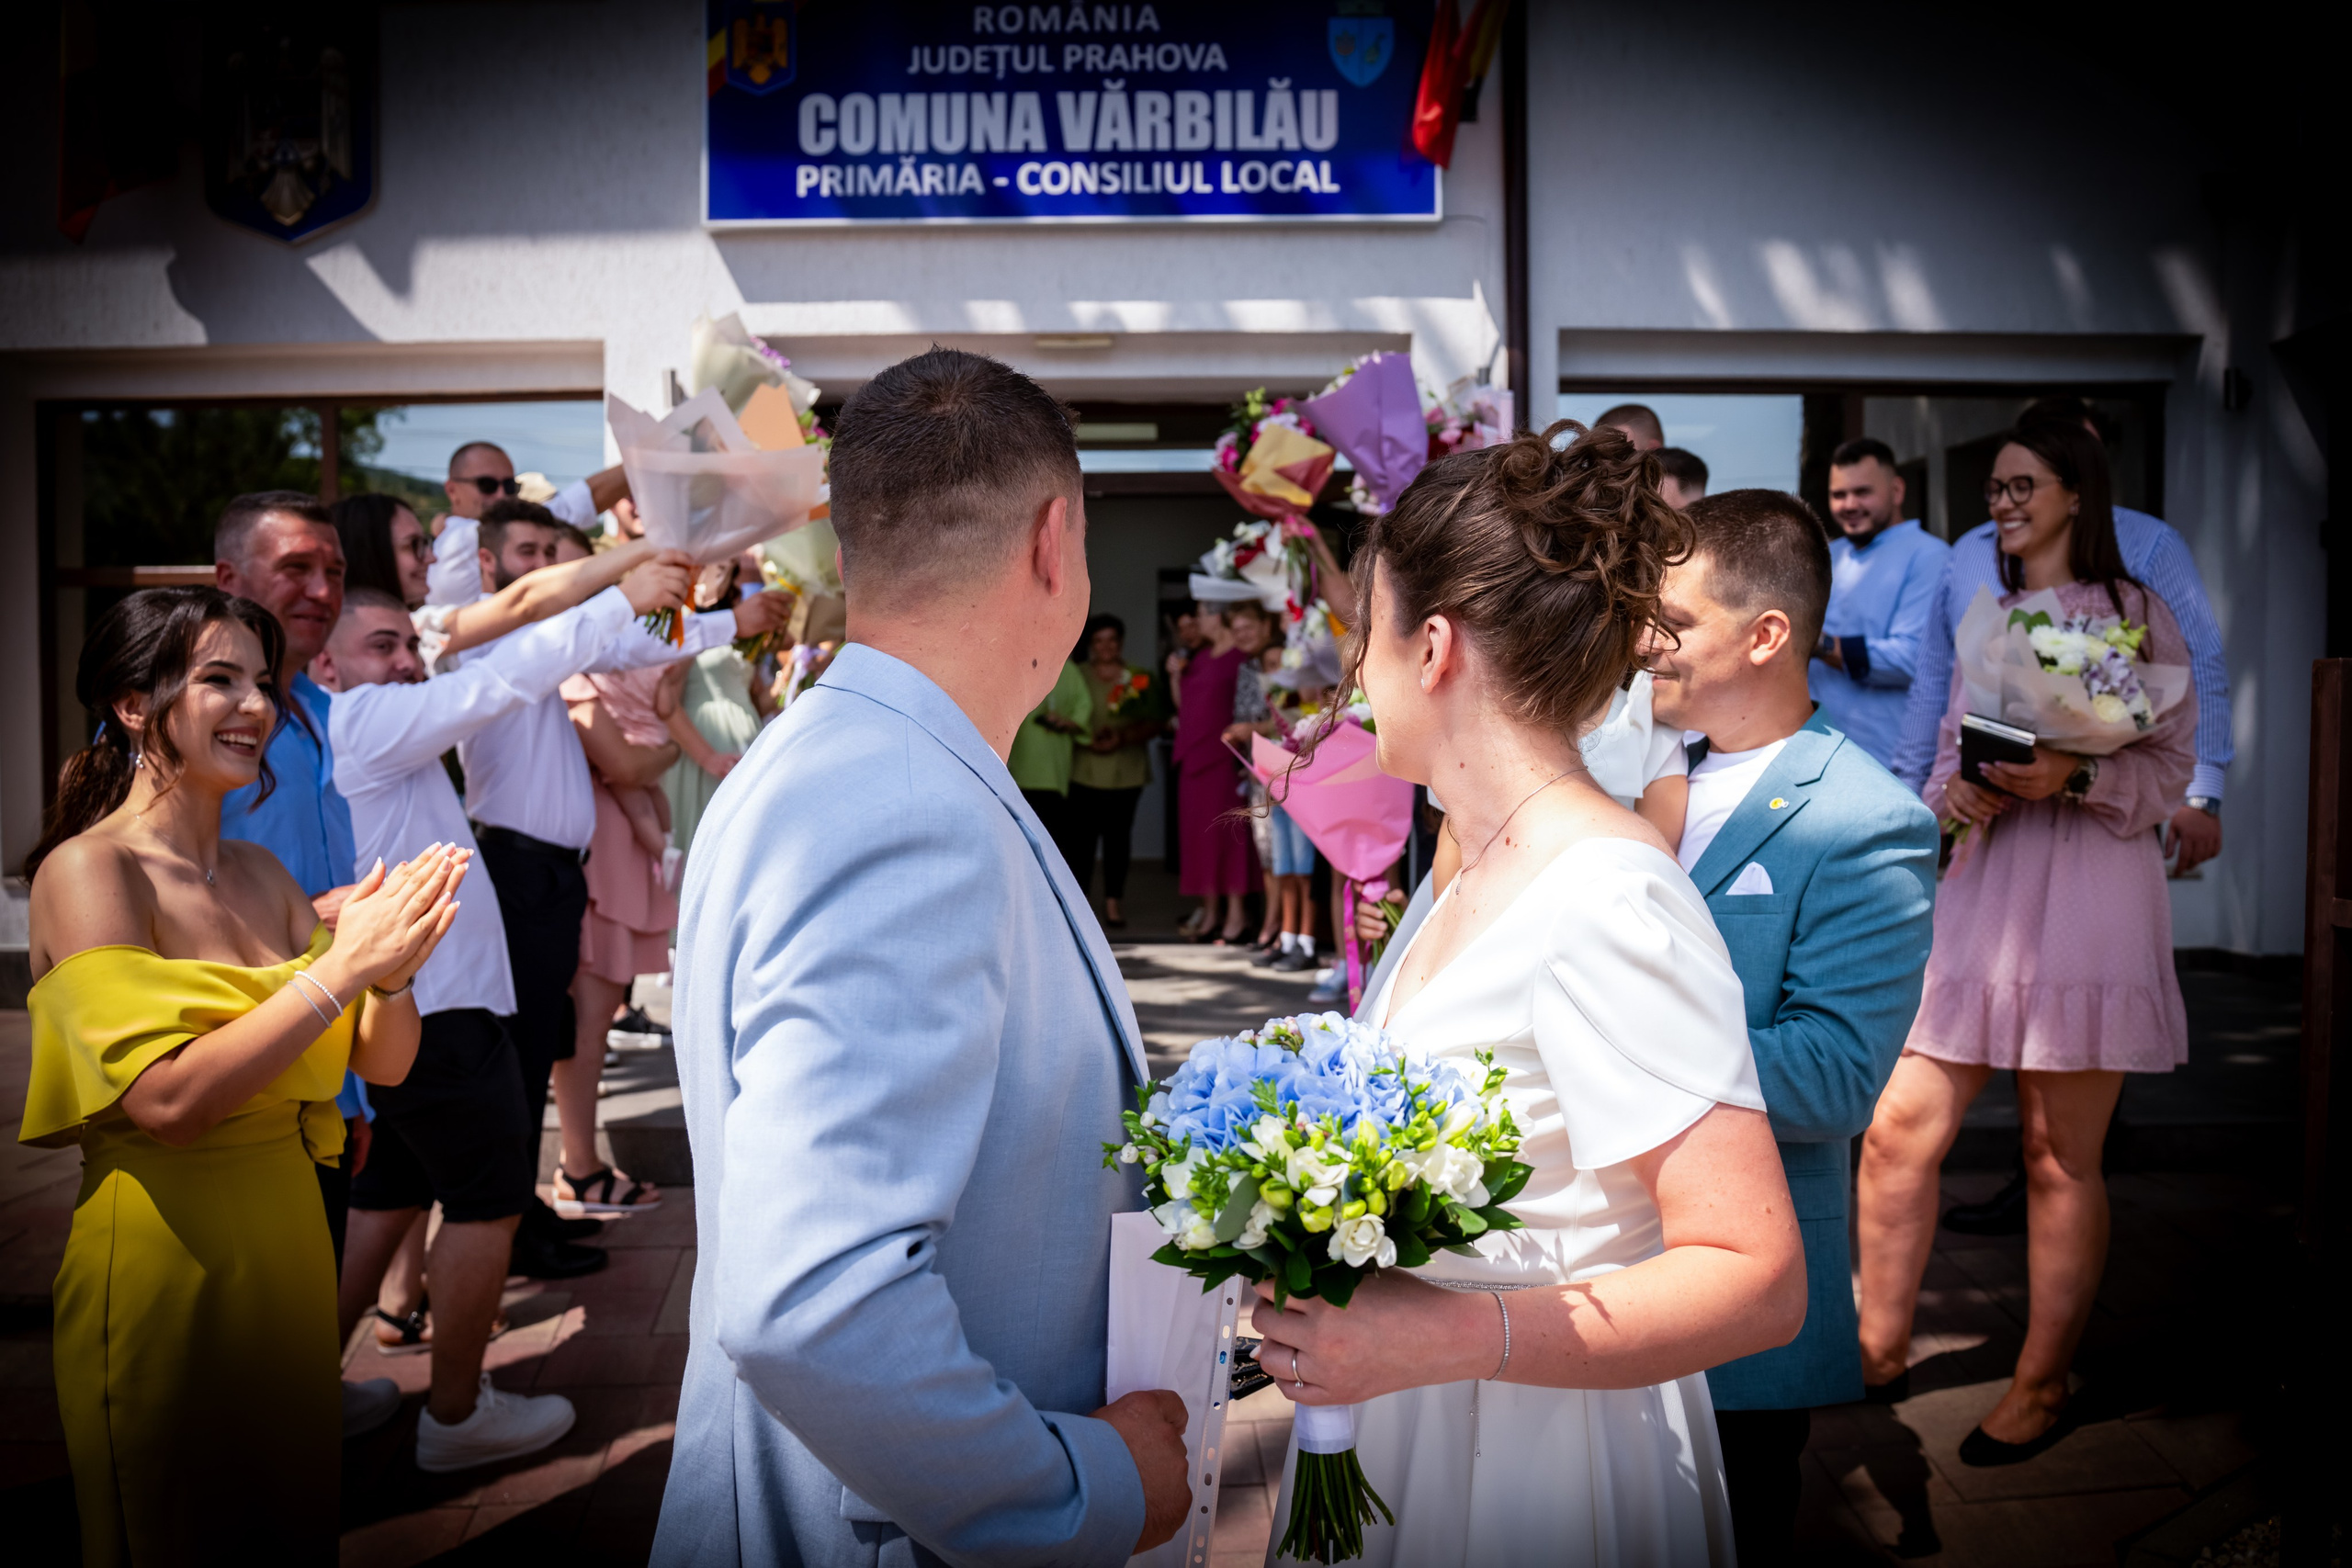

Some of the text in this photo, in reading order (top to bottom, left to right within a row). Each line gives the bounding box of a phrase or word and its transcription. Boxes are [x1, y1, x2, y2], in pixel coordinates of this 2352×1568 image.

[972, 0, 1160, 34] ROMÂNIA
[906, 42, 1227, 80] JUDEȚUL PRAHOVA
[798, 77, 1339, 155] COMUNA VĂRBILĂU
[795, 155, 985, 198] PRIMĂRIA
[1015, 160, 1214, 196] CONSILIUL
[1220, 160, 1340, 194] LOCAL
